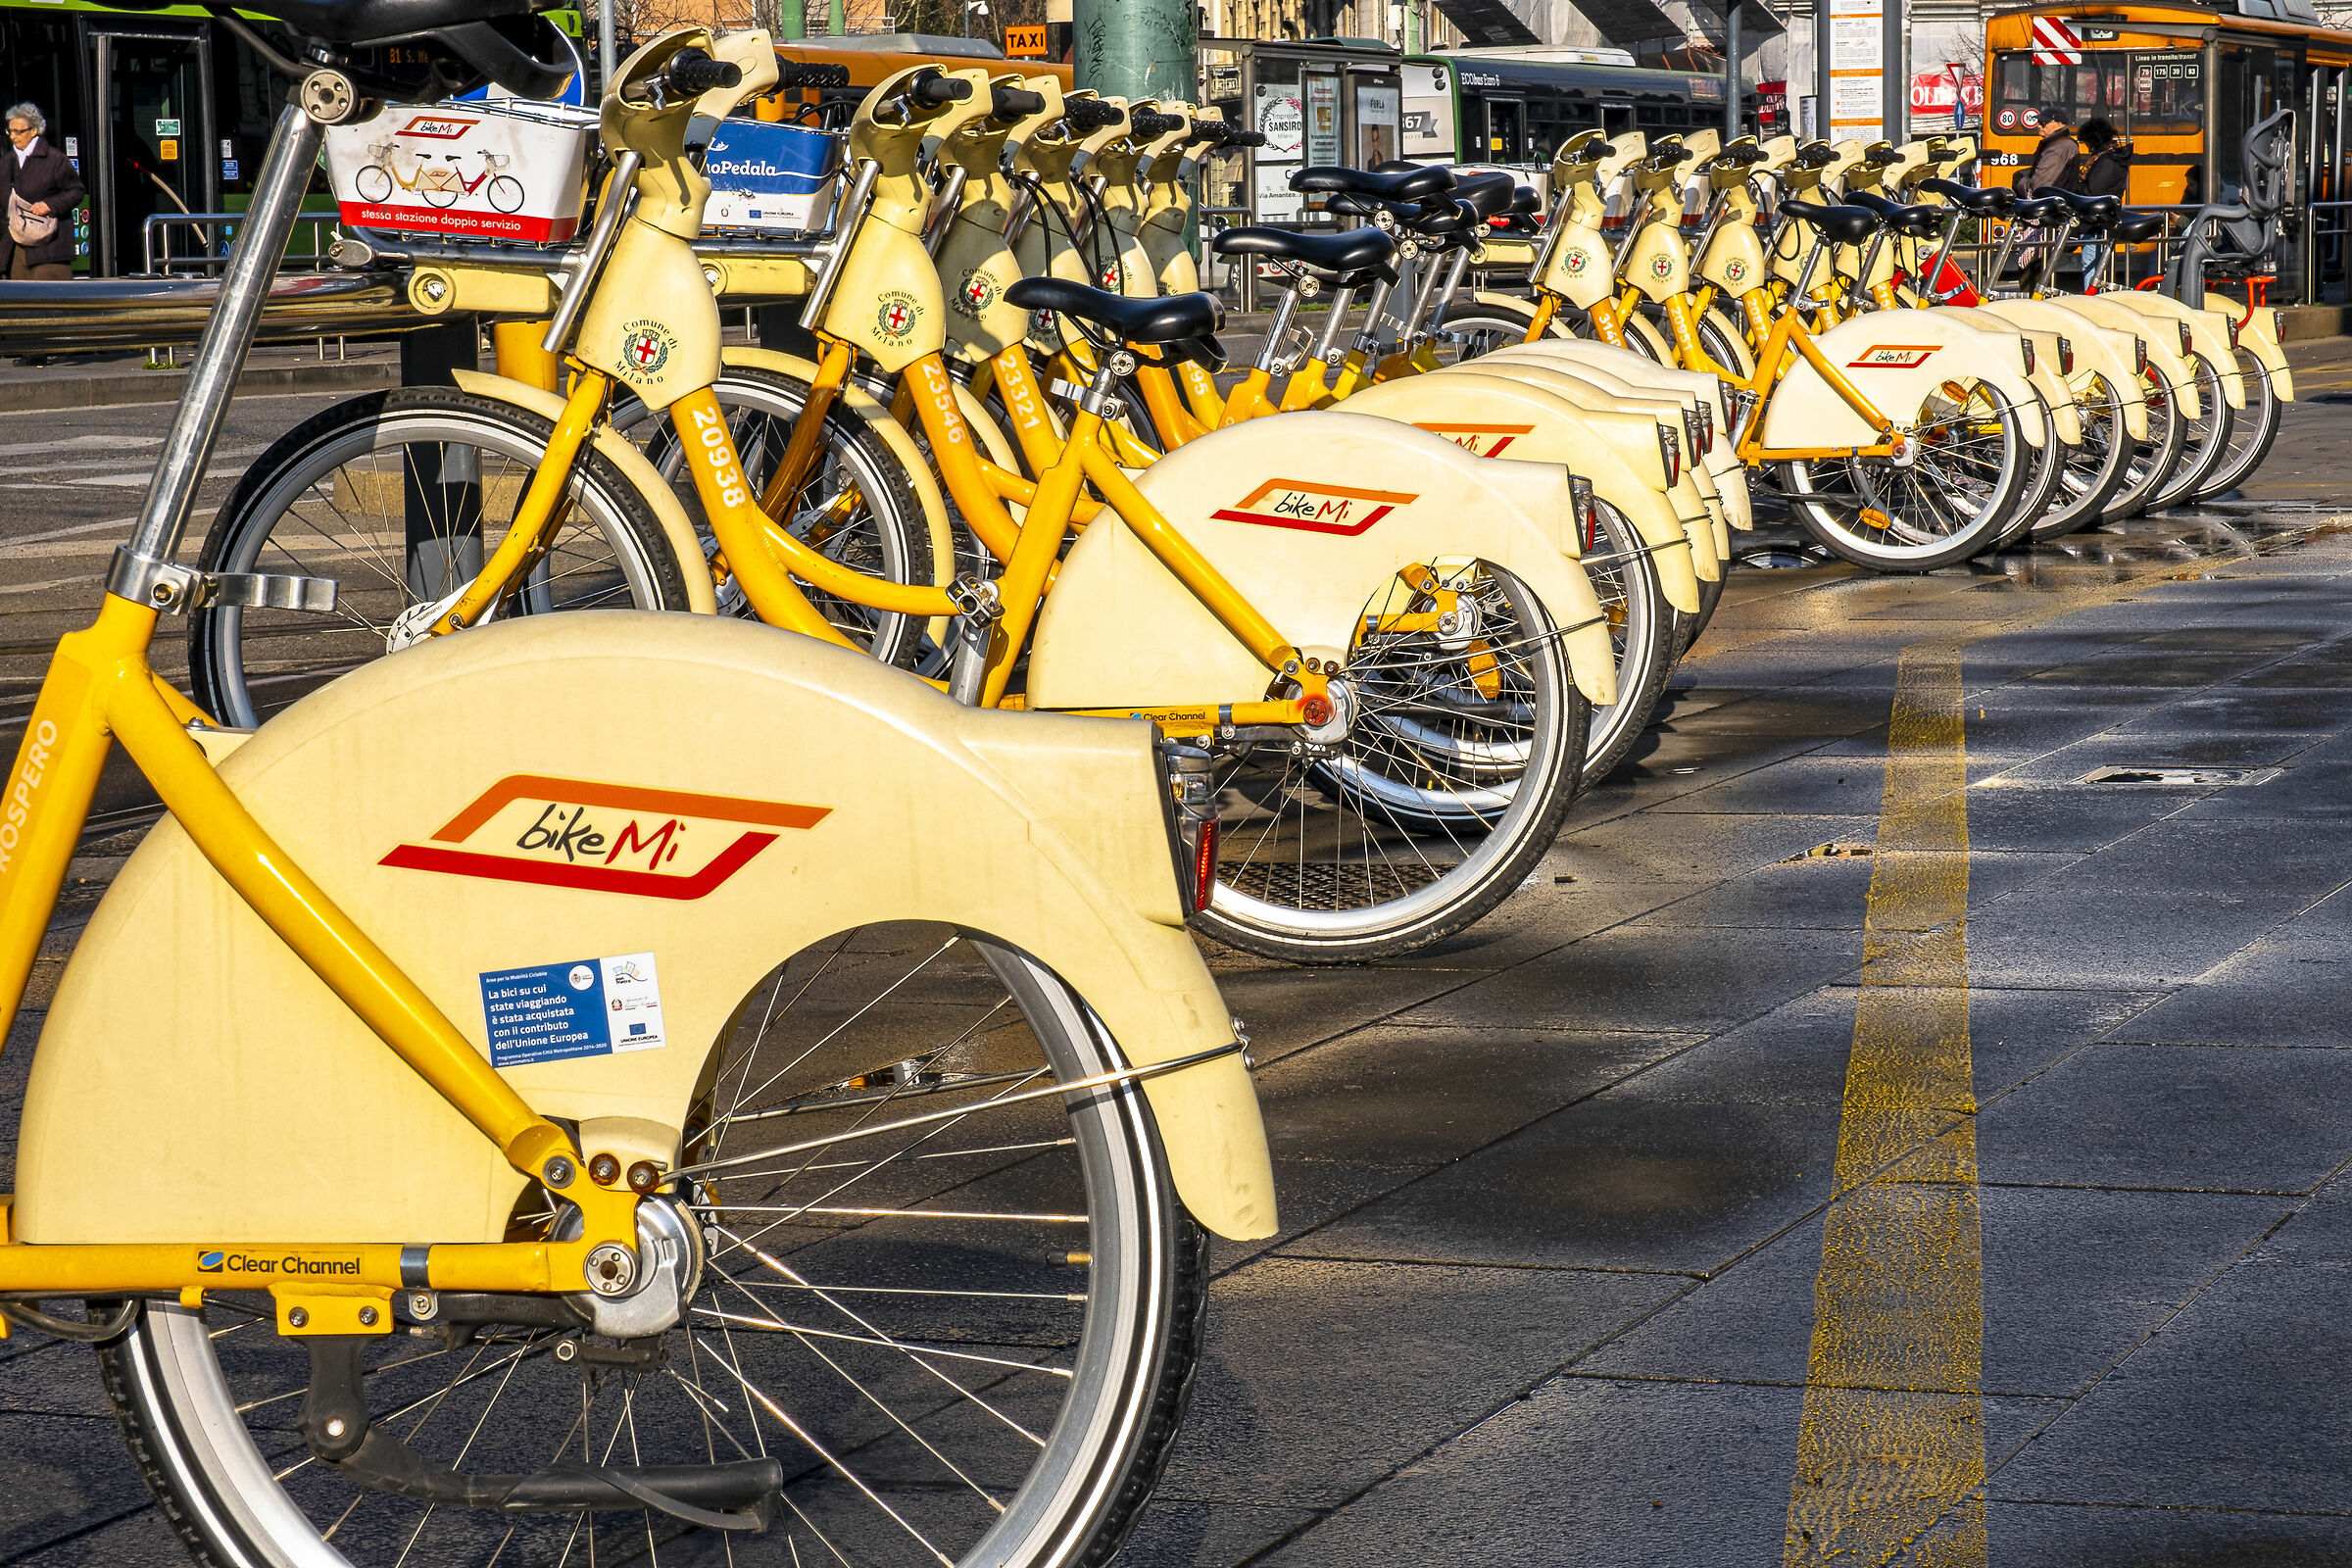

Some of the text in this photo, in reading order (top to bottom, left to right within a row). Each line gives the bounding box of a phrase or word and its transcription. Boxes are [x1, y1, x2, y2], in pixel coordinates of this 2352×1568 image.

[1008, 33, 1044, 48] TAXI
[1461, 73, 1500, 86] ECObus Euro 6
[420, 121, 453, 134] bikeMi
[1268, 121, 1302, 131] SANSIRO
[1402, 116, 1423, 128] 67
[1990, 154, 2018, 166] 968
[362, 209, 521, 231] stessa stazione doppio servizio
[961, 268, 1003, 295] Comune di
[1560, 266, 1584, 278] Milano
[877, 290, 924, 317] Comune di
[1877, 283, 1892, 311] 215
[1746, 298, 1769, 342] 20872
[622, 318, 678, 349] Comune di
[870, 326, 912, 348] Milano
[1875, 350, 1912, 363] bikeMi
[613, 360, 664, 385] Milano
[998, 354, 1041, 429] 23321
[922, 361, 965, 444] 23546
[692, 406, 746, 509] 20938
[1274, 492, 1352, 523] bikeMi
[1143, 711, 1205, 721] Clear Channel
[515, 803, 686, 871] bikeMi
[488, 990, 500, 1000] La
[501, 987, 517, 998] bici
[532, 983, 547, 994] cui
[490, 995, 567, 1011] state viaggiando
[492, 1007, 574, 1025] è stata acquistata
[493, 1021, 569, 1038] con il contributo
[495, 1032, 589, 1051] dell'Unione Europea
[226, 1253, 361, 1275] Clear Channel
